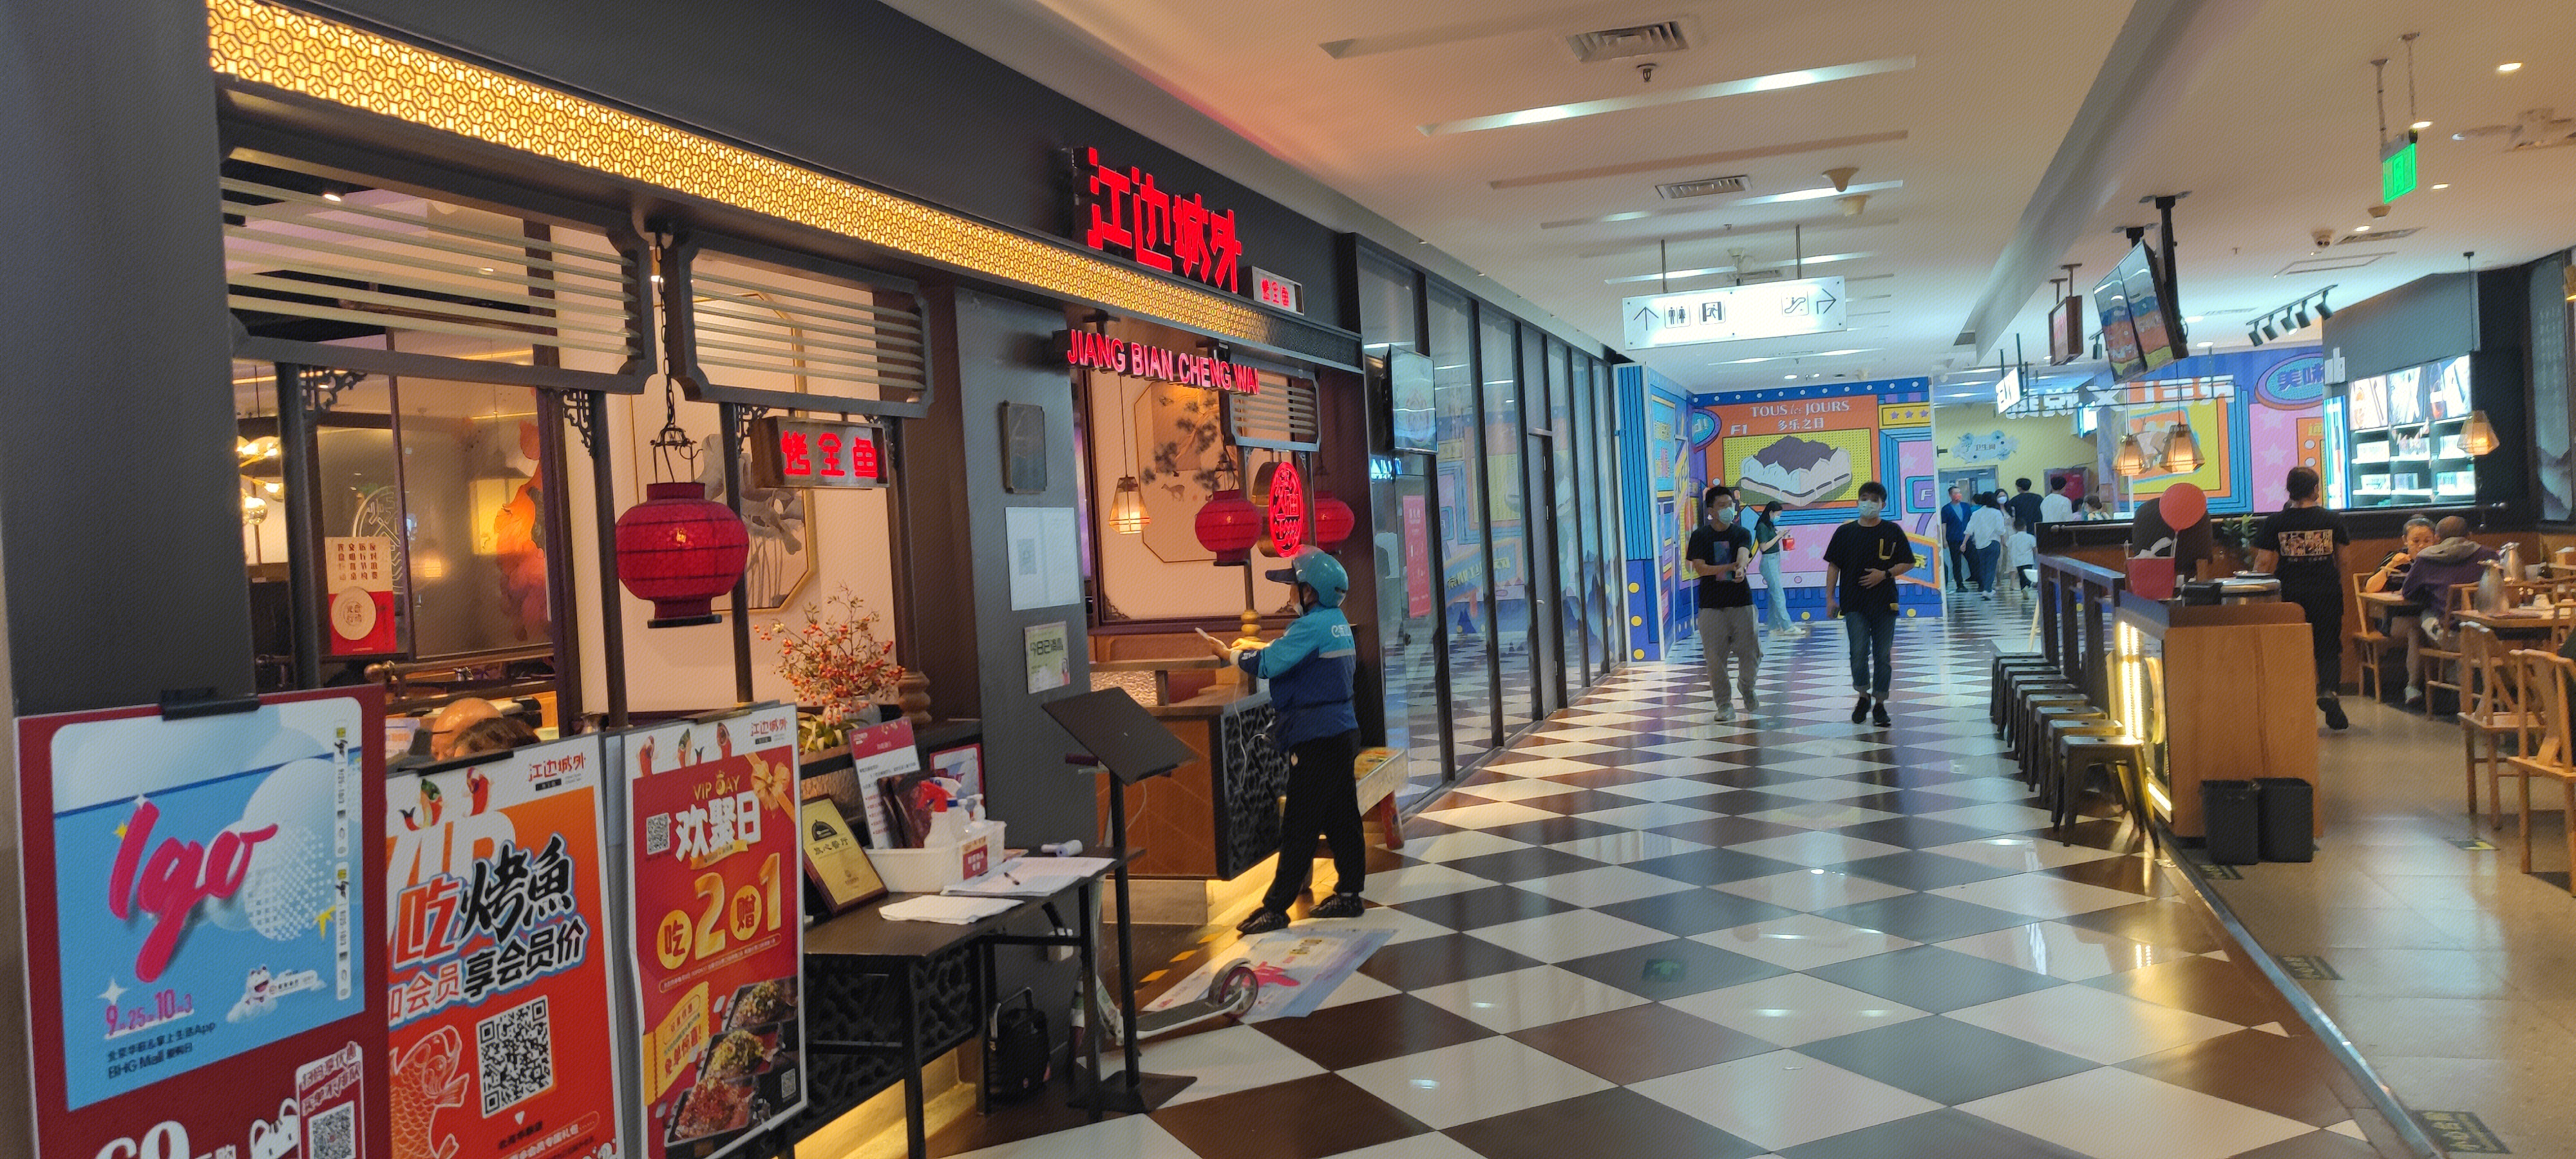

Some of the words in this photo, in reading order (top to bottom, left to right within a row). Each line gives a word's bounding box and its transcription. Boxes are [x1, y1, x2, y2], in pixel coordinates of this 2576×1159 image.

[1087, 146, 1242, 294] 江边城外
[1067, 329, 1126, 373] JIANG
[1132, 343, 1173, 380] BIAN
[1178, 352, 1231, 391] CHENG
[1233, 362, 1260, 395] WAI
[1750, 405, 1788, 417] TOUS
[1790, 404, 1803, 414] les
[1806, 400, 1850, 416] JOURS
[1730, 424, 1748, 435] F1
[1778, 417, 1824, 431] 多乐之日
[750, 717, 788, 737] 江边城外
[528, 752, 587, 782] 江边城外
[693, 782, 712, 801] VIP
[675, 789, 762, 863] 欢聚日
[109, 1059, 137, 1080] BHG
[140, 1050, 164, 1069] Mall
